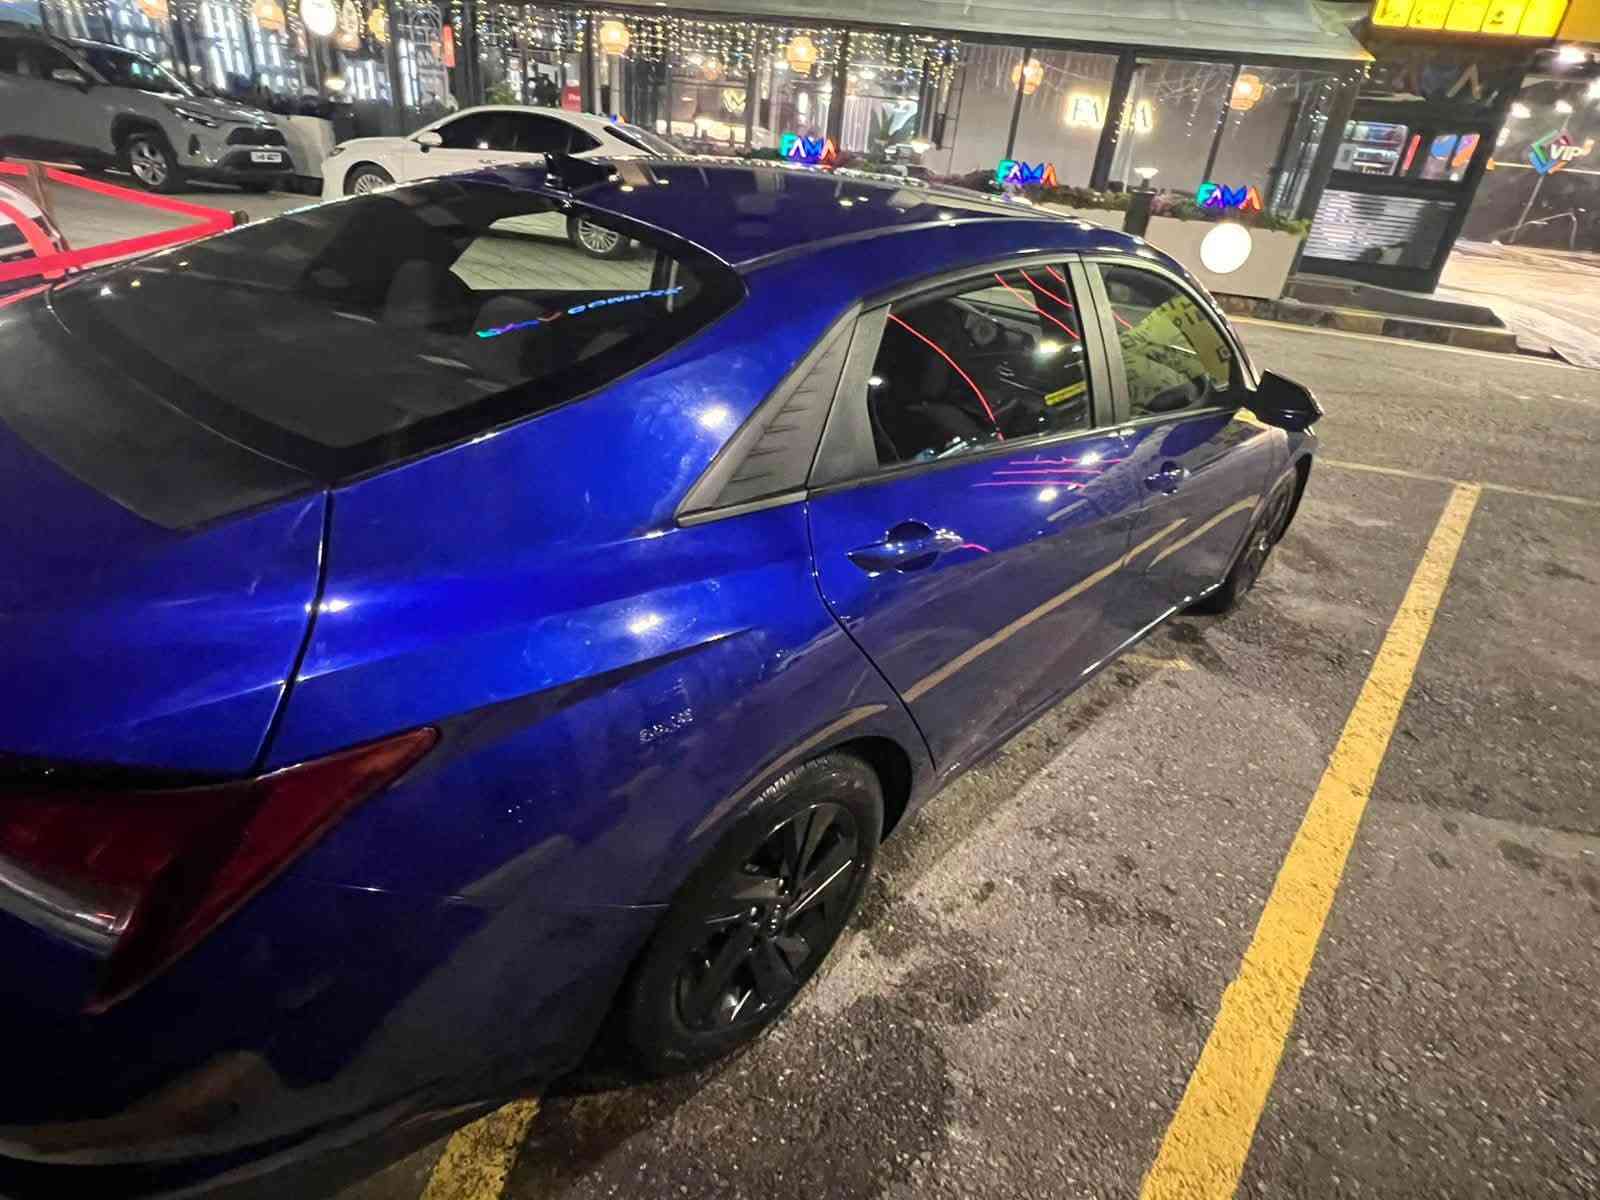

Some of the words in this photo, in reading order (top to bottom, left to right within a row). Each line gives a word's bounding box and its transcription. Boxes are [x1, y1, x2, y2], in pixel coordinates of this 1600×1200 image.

[780, 133, 837, 160] FAMA
[996, 160, 1057, 185] FAMA
[1196, 183, 1264, 208] FAMA
